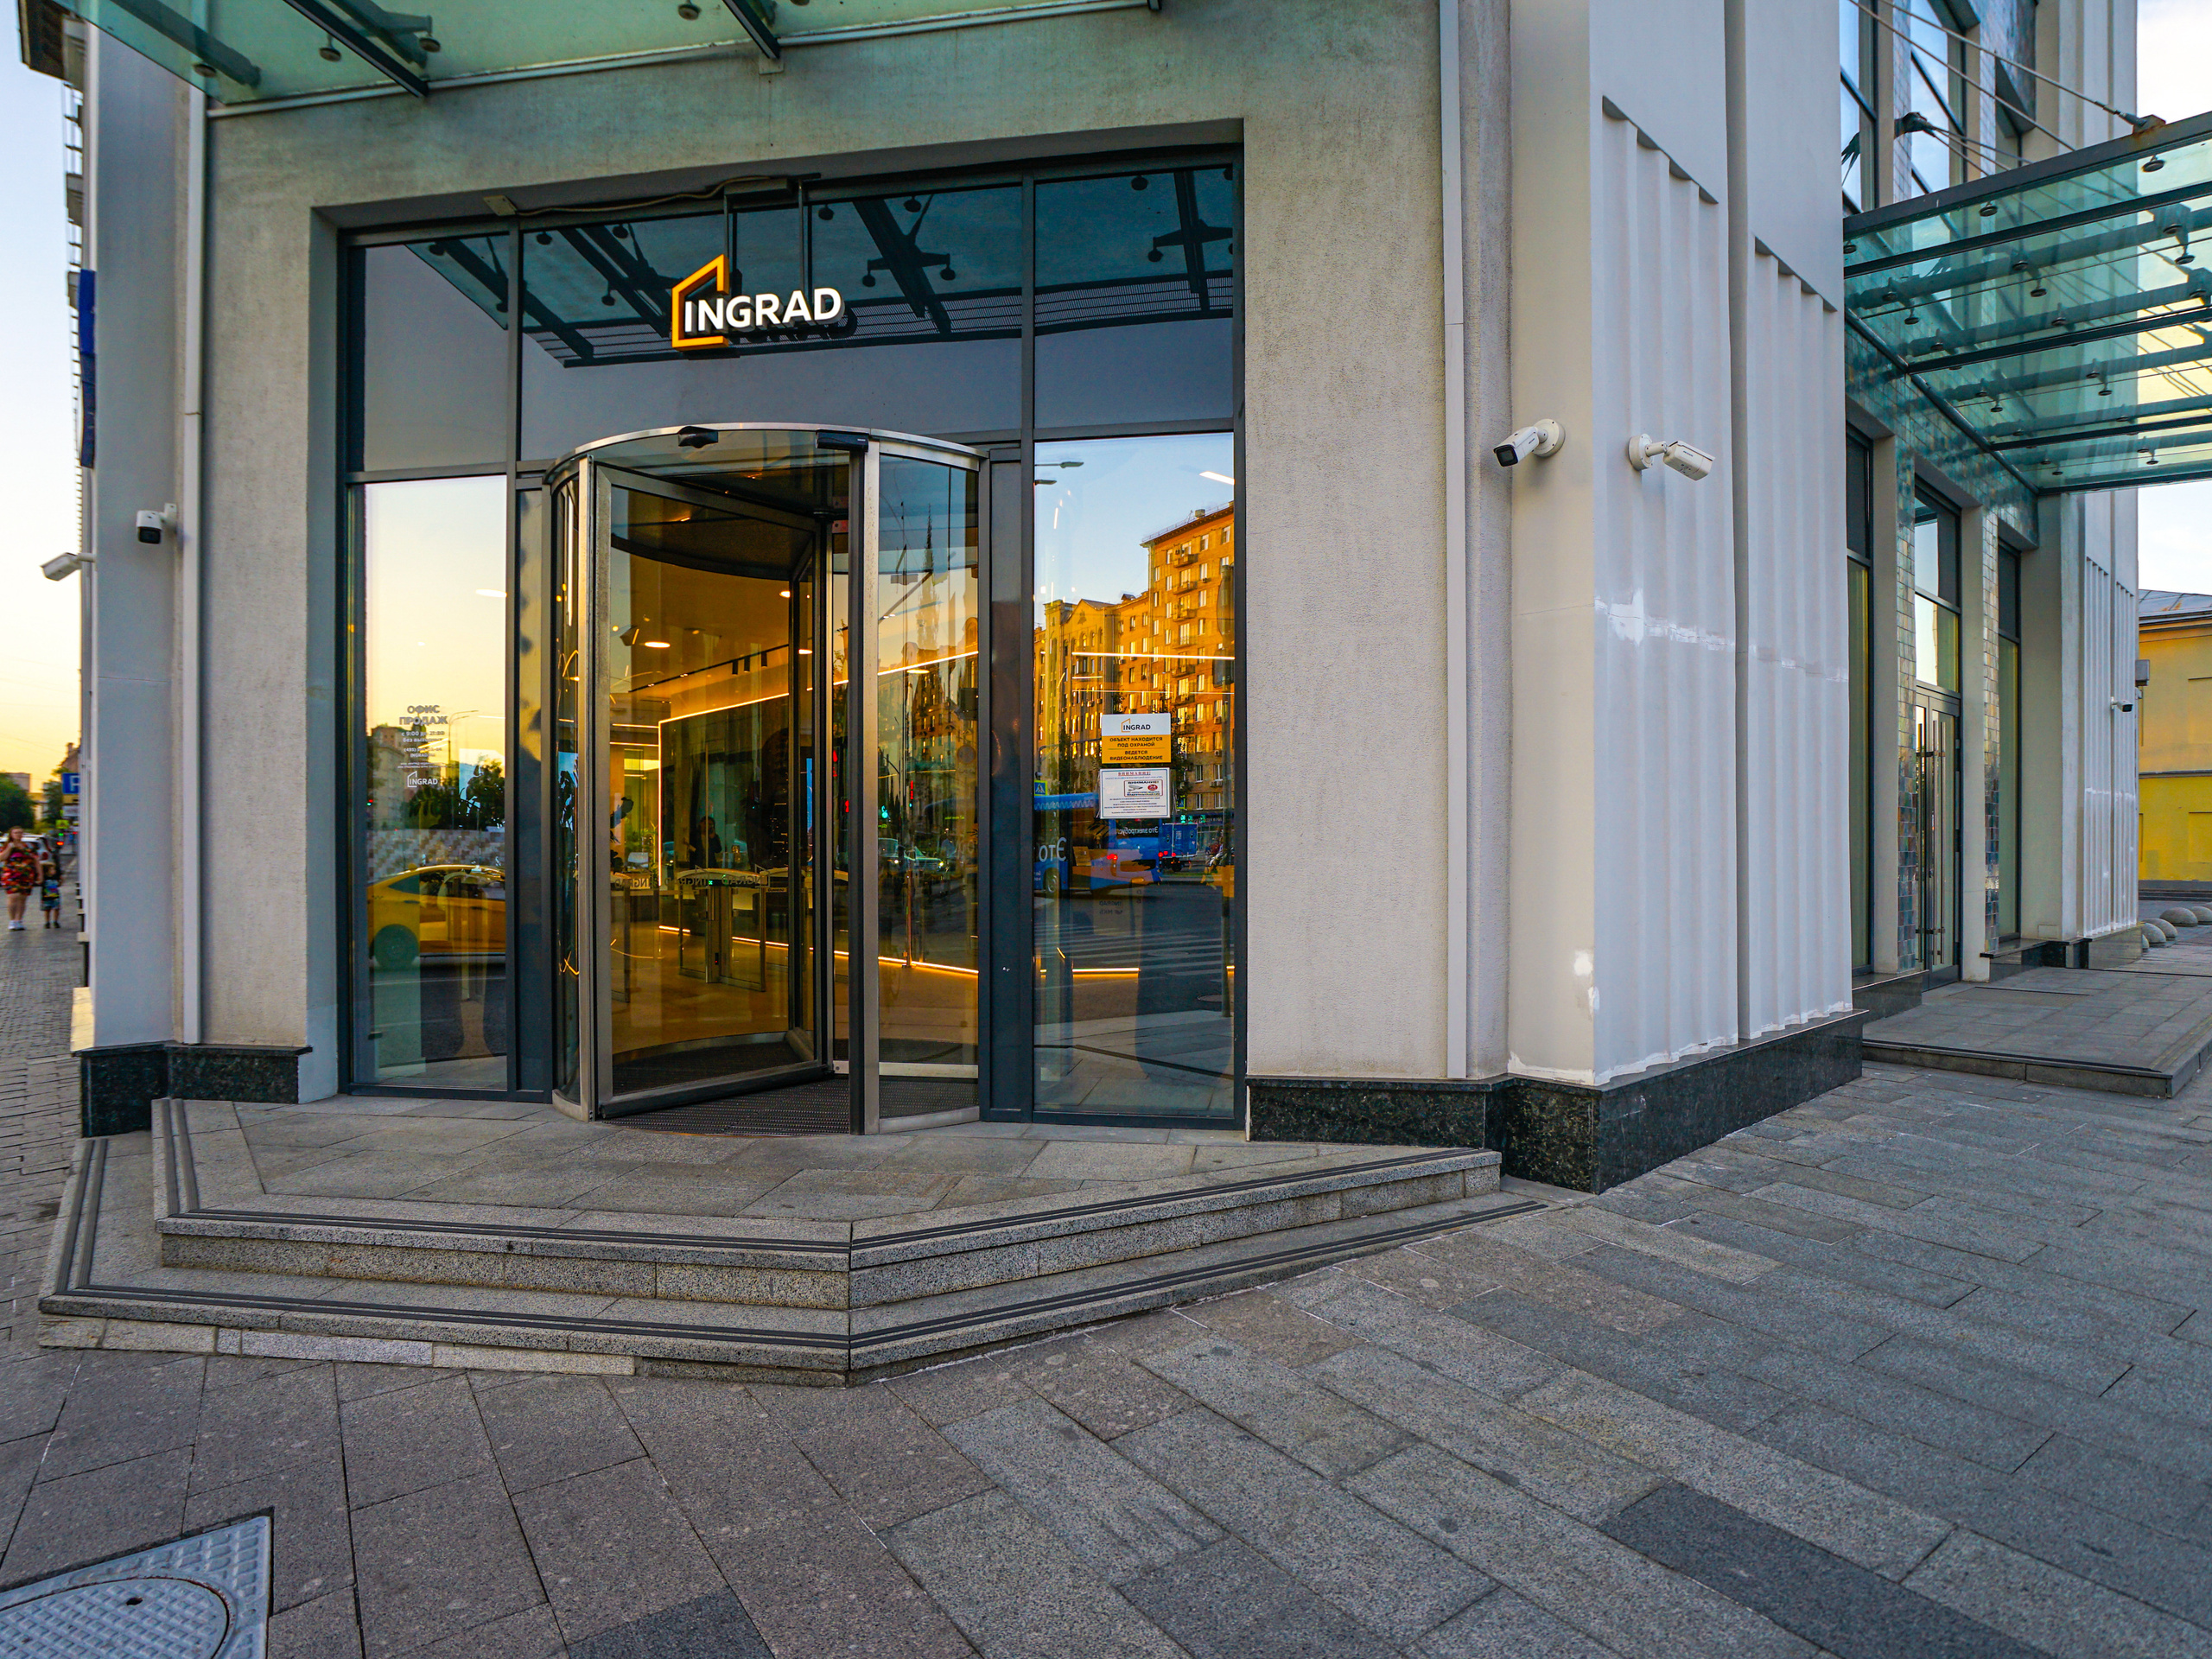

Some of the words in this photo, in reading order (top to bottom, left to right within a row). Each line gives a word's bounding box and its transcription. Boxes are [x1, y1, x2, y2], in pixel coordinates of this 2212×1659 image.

[684, 287, 844, 334] INGRAD
[407, 705, 440, 714] ОФИС
[399, 716, 448, 726] ПРОДАЖ
